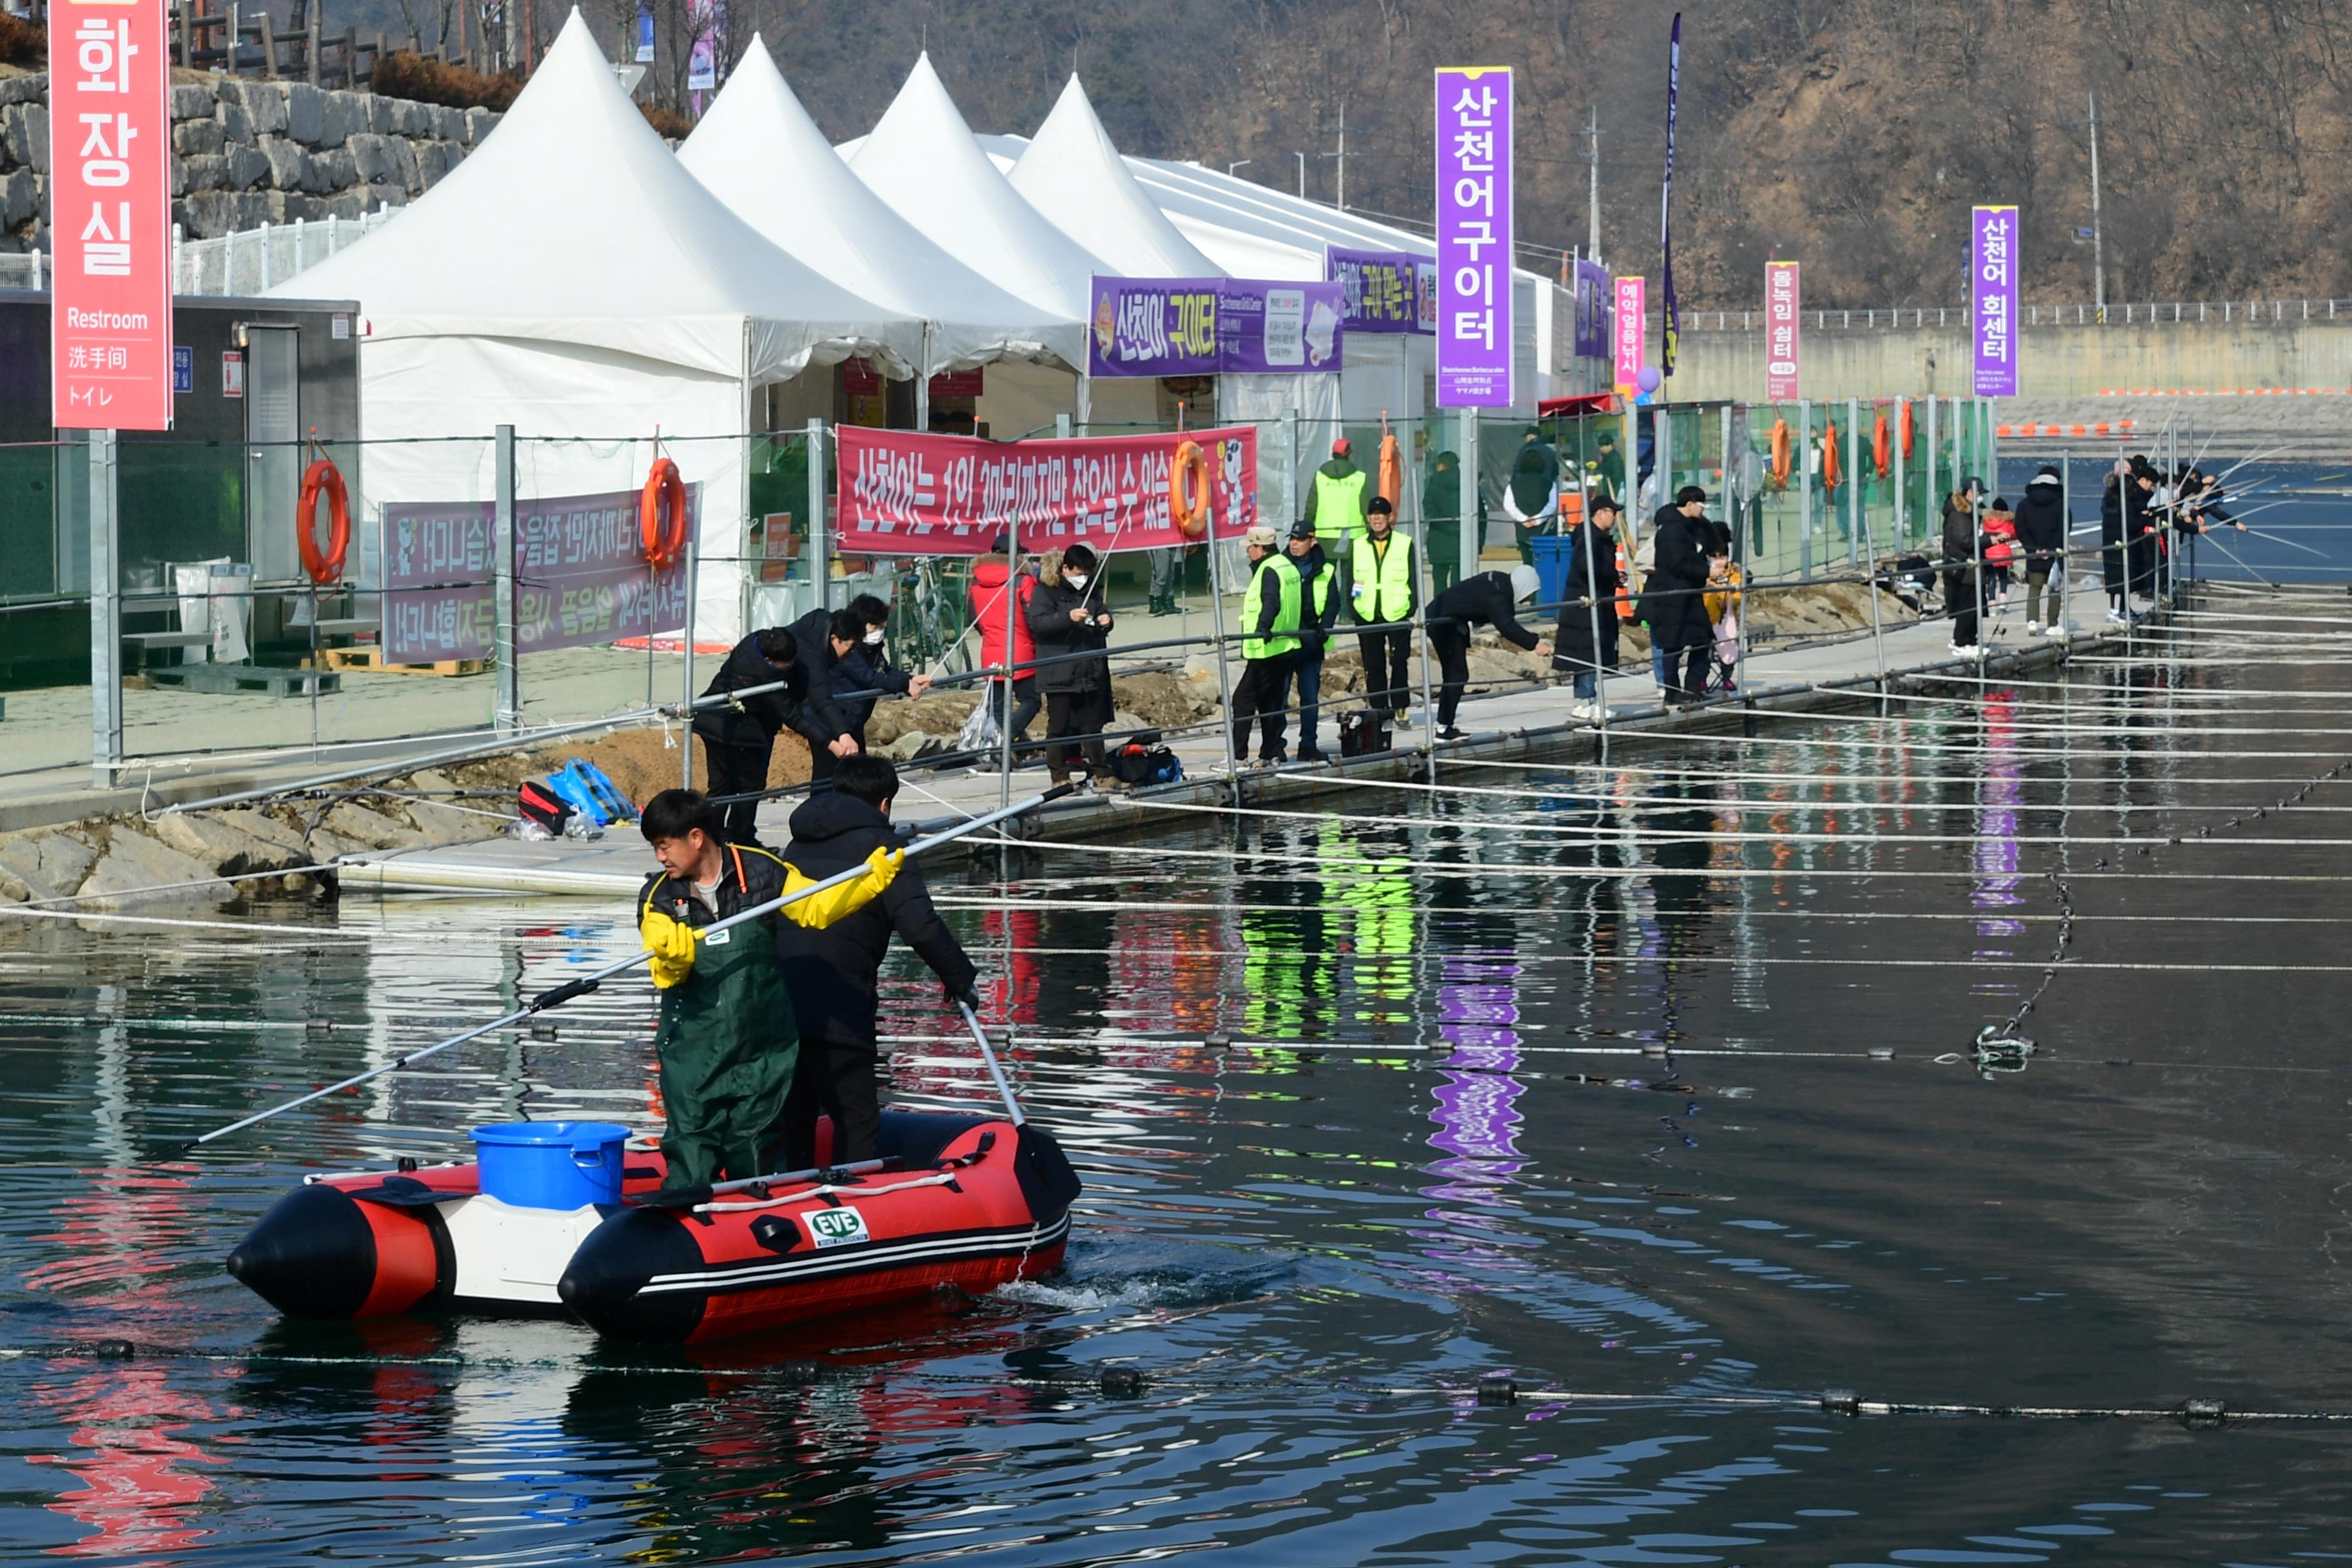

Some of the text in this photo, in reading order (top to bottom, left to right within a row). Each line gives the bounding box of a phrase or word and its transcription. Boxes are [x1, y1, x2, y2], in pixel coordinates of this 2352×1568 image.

[75, 19, 139, 276] 화장실
[1452, 86, 1498, 350] 산천어구이터
[1982, 218, 2009, 286] 산천어
[68, 306, 148, 329] Restroom
[1116, 293, 1215, 361] 산천어 구이터
[1772, 326, 1792, 359] 쉼터
[1981, 294, 2006, 363] 회센터
[68, 346, 127, 369] 洗手间
[70, 386, 113, 407] トイレ
[854, 447, 936, 536] 산천어는
[943, 455, 976, 536] 1인
[976, 455, 1068, 538] 3마리까지만
[1072, 453, 1119, 535] 잡으실
[1122, 453, 1139, 533] 수
[815, 1213, 857, 1234] EVE
